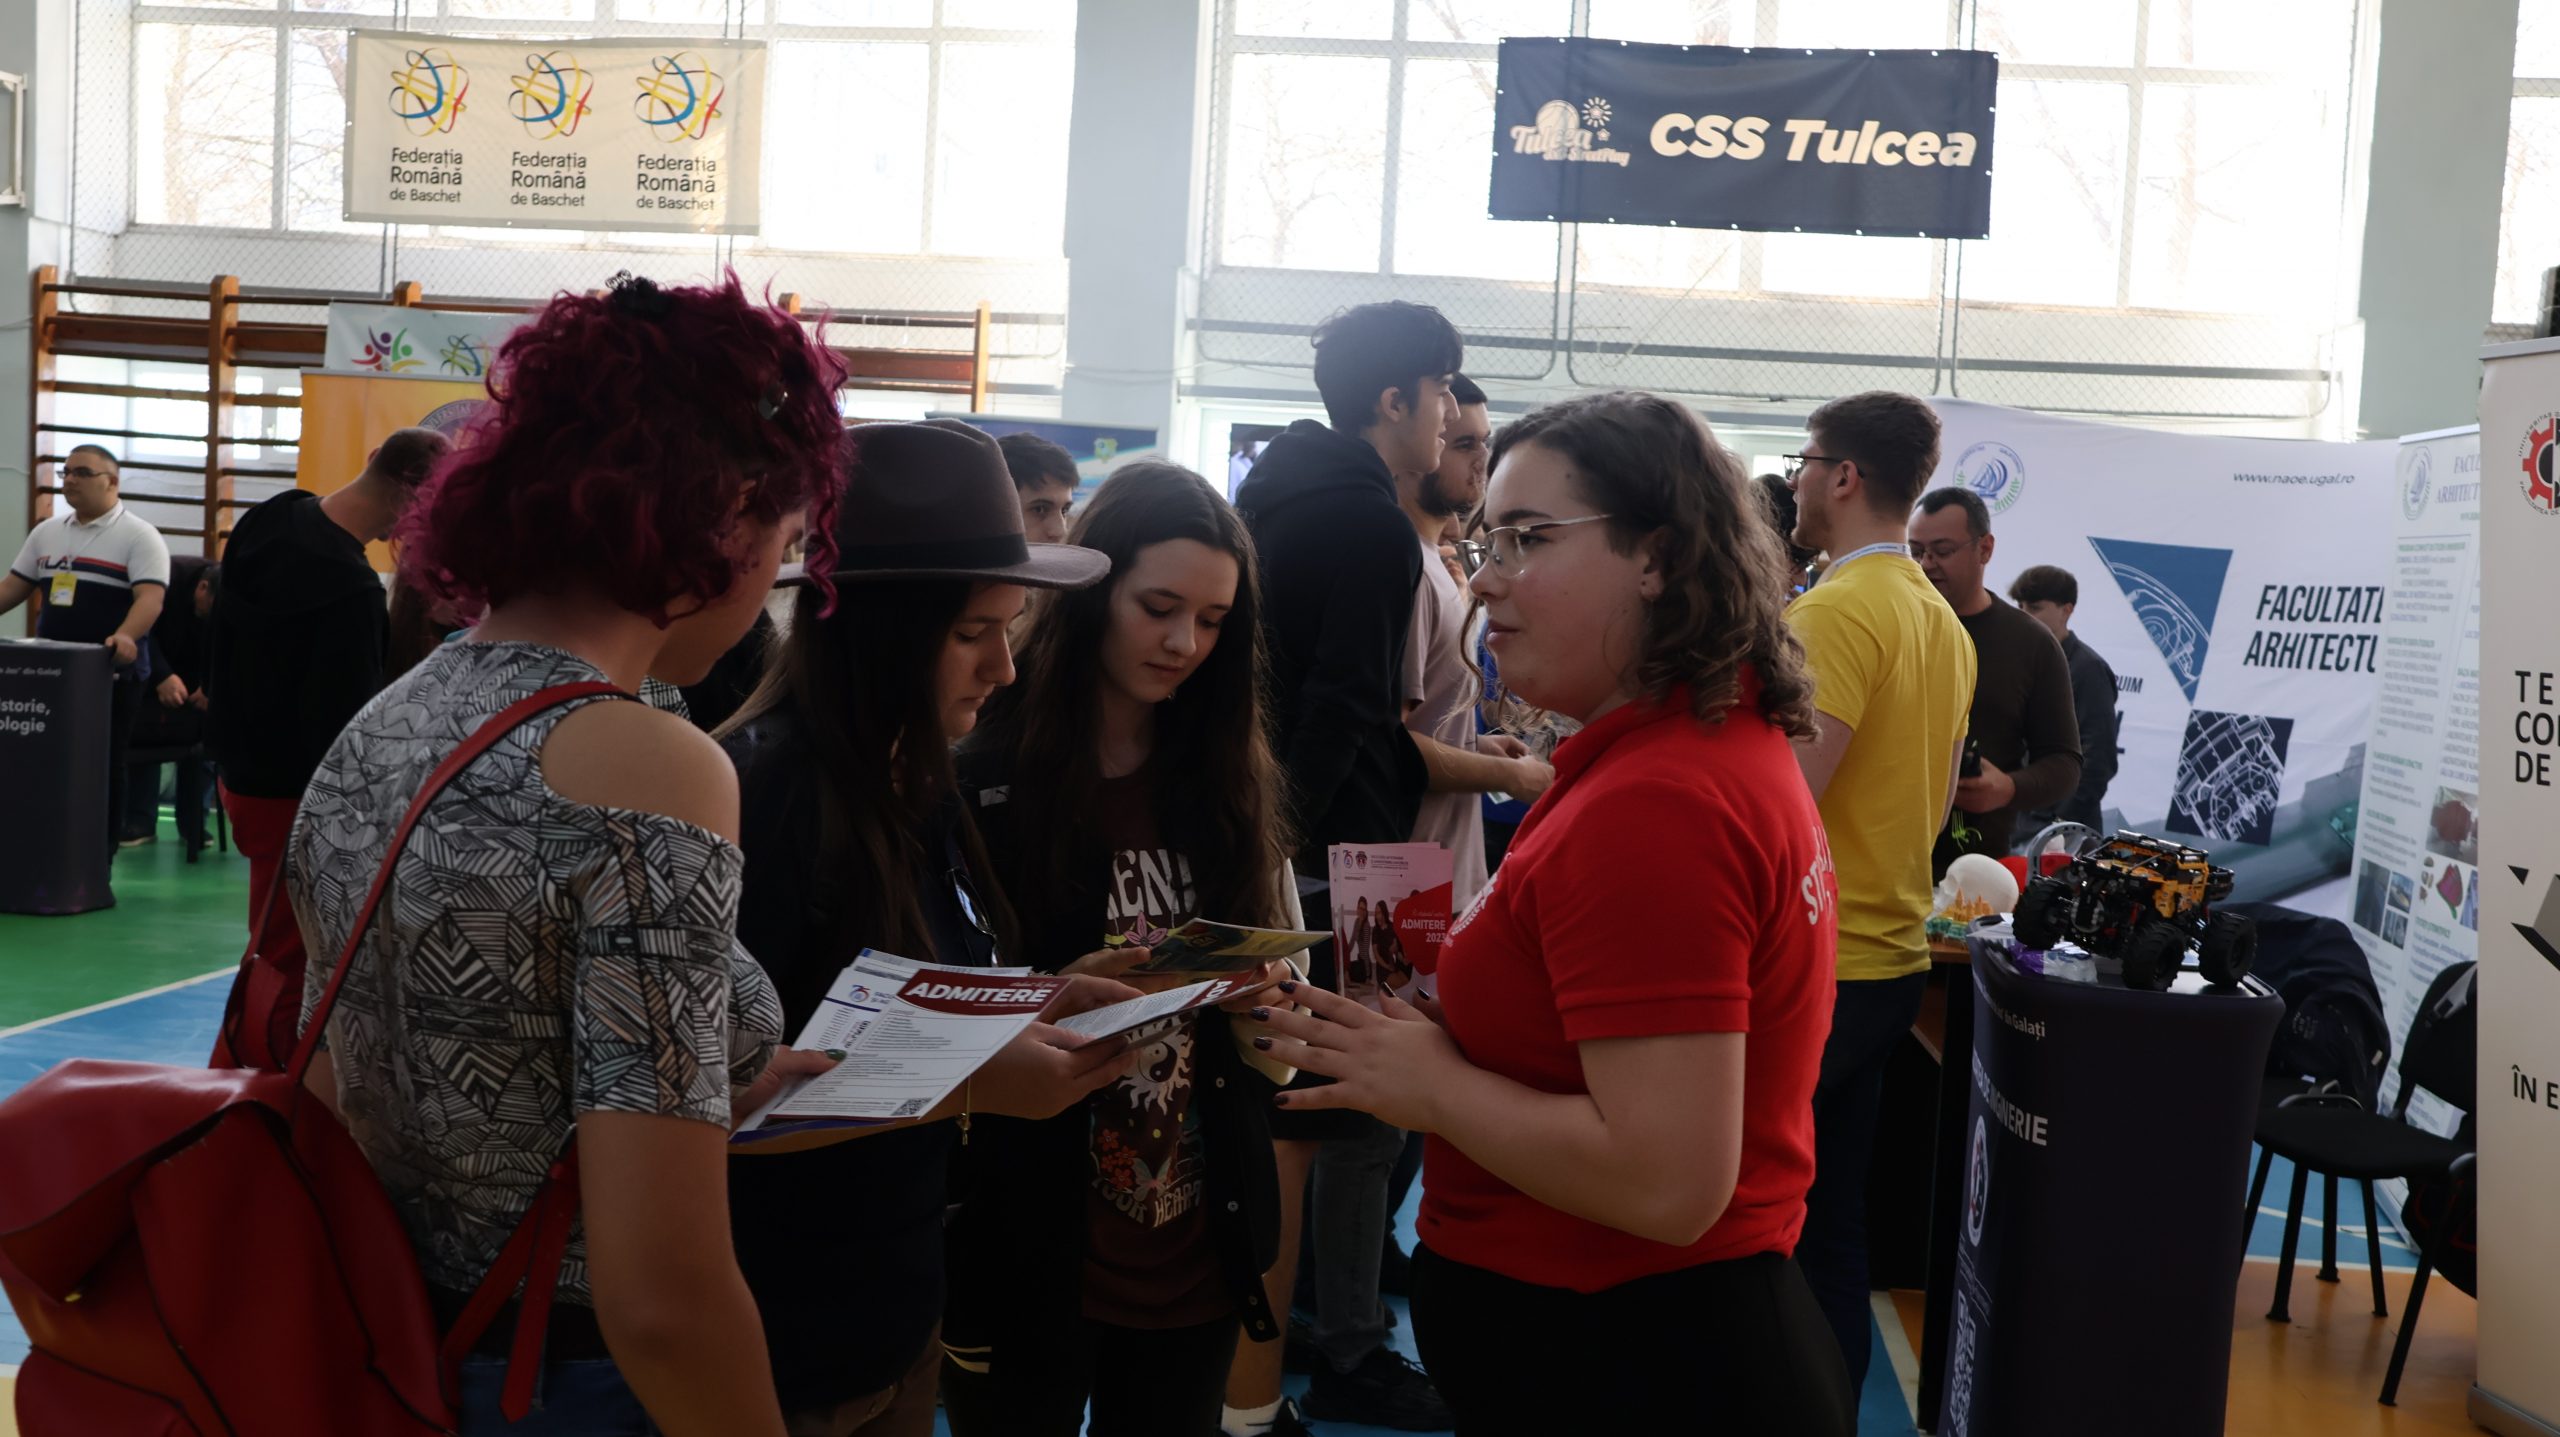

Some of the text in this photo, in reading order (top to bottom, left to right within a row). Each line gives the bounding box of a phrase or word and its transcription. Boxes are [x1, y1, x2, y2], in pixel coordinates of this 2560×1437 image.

[1650, 113, 1977, 167] CSS Tulcea
[391, 166, 462, 185] Română
[511, 170, 586, 189] Română
[637, 173, 715, 193] Română
[390, 187, 461, 202] de Baschet
[511, 191, 585, 206] de Baschet
[636, 195, 714, 210] de Baschet
[0, 697, 51, 716] storie,
[2515, 710, 2560, 747] CO
[2515, 750, 2551, 787] DE
[1401, 919, 1446, 931] ADMITERE
[906, 981, 1053, 1004] ADMITERE
[2511, 1064, 2537, 1104] ÎN
